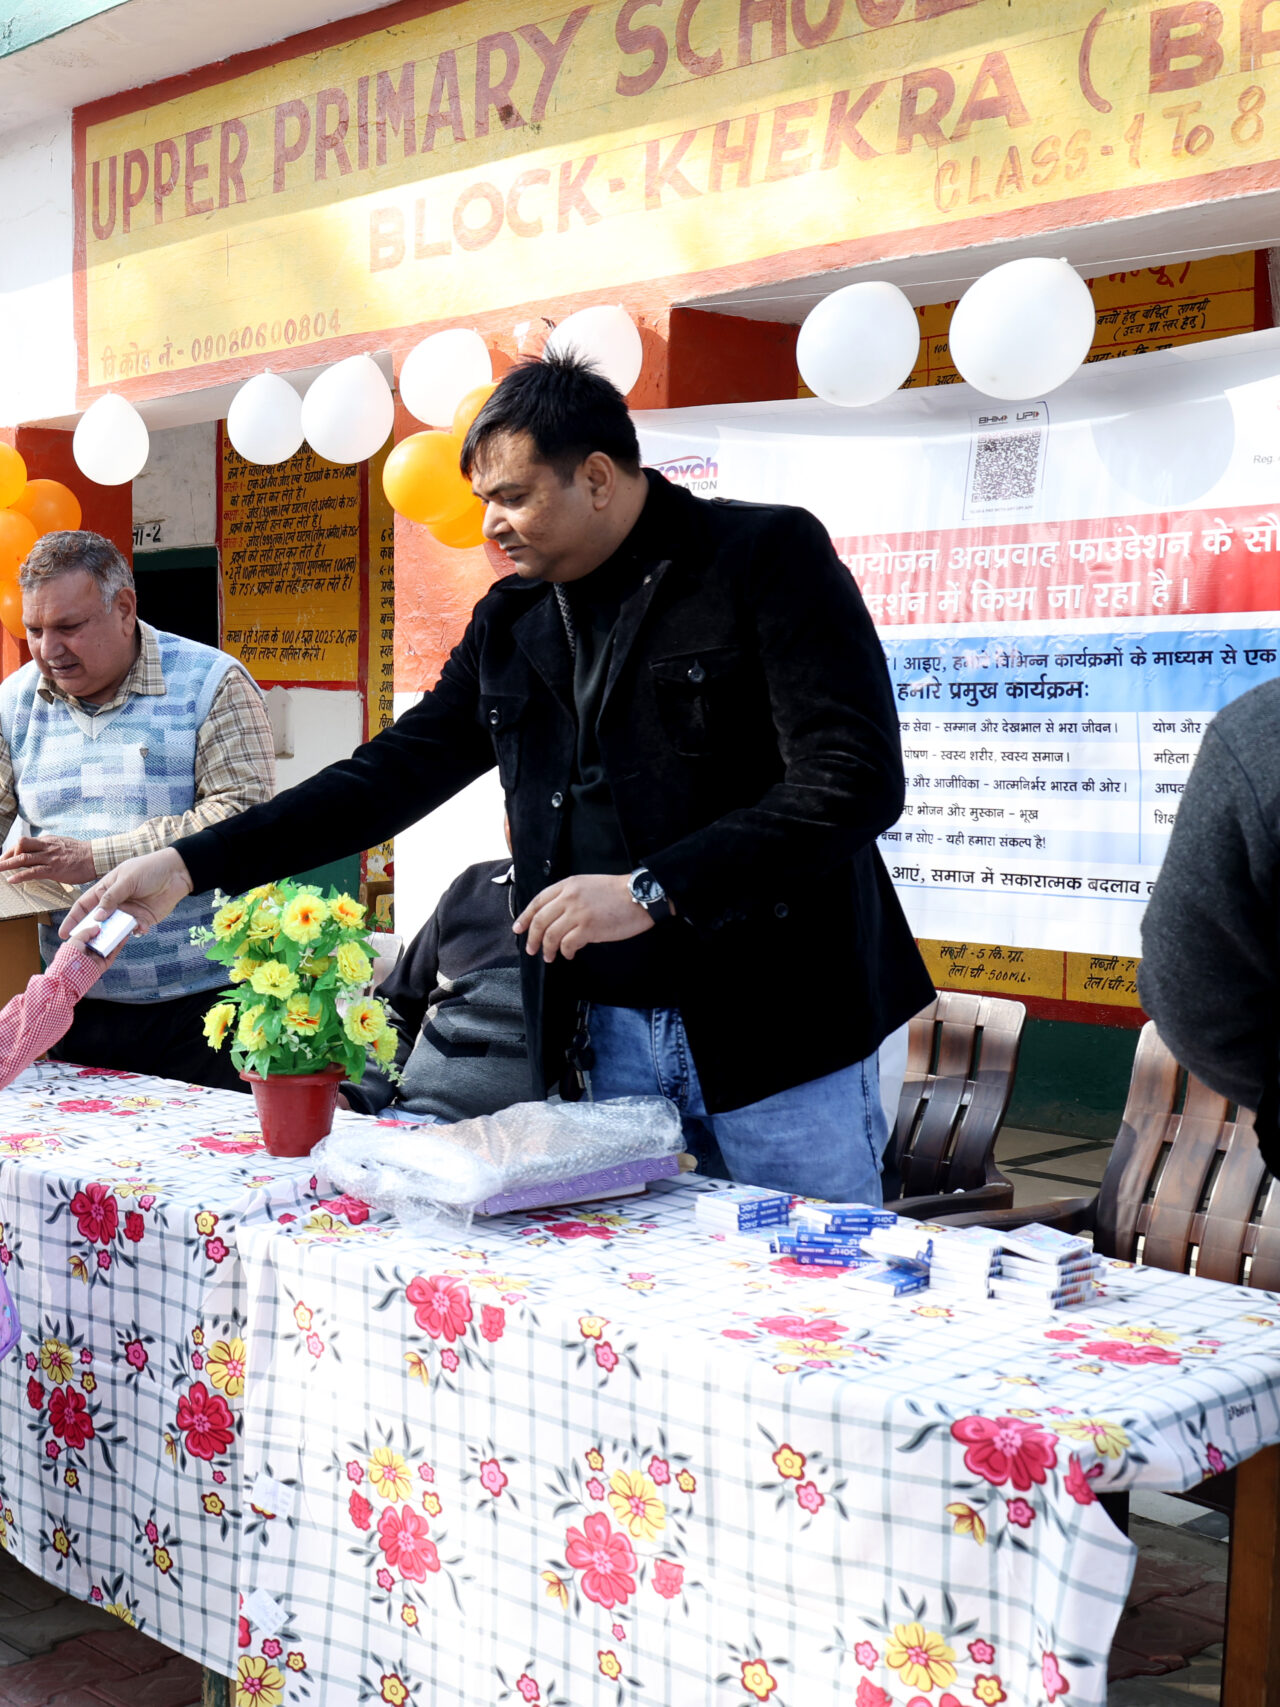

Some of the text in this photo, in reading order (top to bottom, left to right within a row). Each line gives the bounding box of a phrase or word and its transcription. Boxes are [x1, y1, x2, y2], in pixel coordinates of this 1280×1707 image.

[92, 0, 984, 240] UPPER PRIMARY SCHO
[1162, 101, 1214, 157] To
[1232, 85, 1266, 147] 8
[839, 542, 940, 576] आयोजन
[948, 541, 1060, 570] अवप्रवाह
[1068, 525, 1192, 564] फाउंडेशन
[1201, 517, 1233, 555] के
[937, 580, 961, 613] में
[971, 578, 1037, 612] किया
[1046, 584, 1084, 608] जा
[1093, 581, 1141, 609] रहा
[1054, 646, 1124, 668] कार्यक्रमों
[1129, 646, 1147, 667] के
[1152, 650, 1213, 667] माध्यम
[1220, 644, 1237, 665] से
[1243, 648, 1277, 666] एक
[896, 675, 942, 701] हमारे
[948, 680, 998, 707] प्रमुख
[913, 718, 931, 732] सेवा
[943, 722, 976, 733] सम्मान
[980, 718, 998, 733] और
[1002, 718, 1041, 733] देखभाल
[1045, 718, 1054, 733] से
[1059, 722, 1078, 733] भरा
[1152, 717, 1201, 734] योग और
[1153, 748, 1190, 765] महिला
[913, 773, 930, 788] और
[934, 774, 979, 789] आजीविका
[994, 776, 1047, 791] आत्मनिर्भर
[1050, 780, 1077, 792] भारत
[1082, 778, 1095, 792] की
[917, 802, 943, 816] भोजन
[947, 802, 966, 817] और
[969, 807, 1004, 822] मुस्कान
[1020, 809, 1039, 823] भूख
[905, 832, 913, 842] न
[916, 829, 934, 844] सोए
[945, 831, 964, 845] यही
[968, 834, 995, 847] हमारा
[1000, 834, 1031, 848] संकल्प
[931, 869, 975, 884] समाज
[981, 866, 994, 885] में
[1000, 872, 1082, 890] सकारात्मक
[1087, 877, 1141, 894] बदलाव
